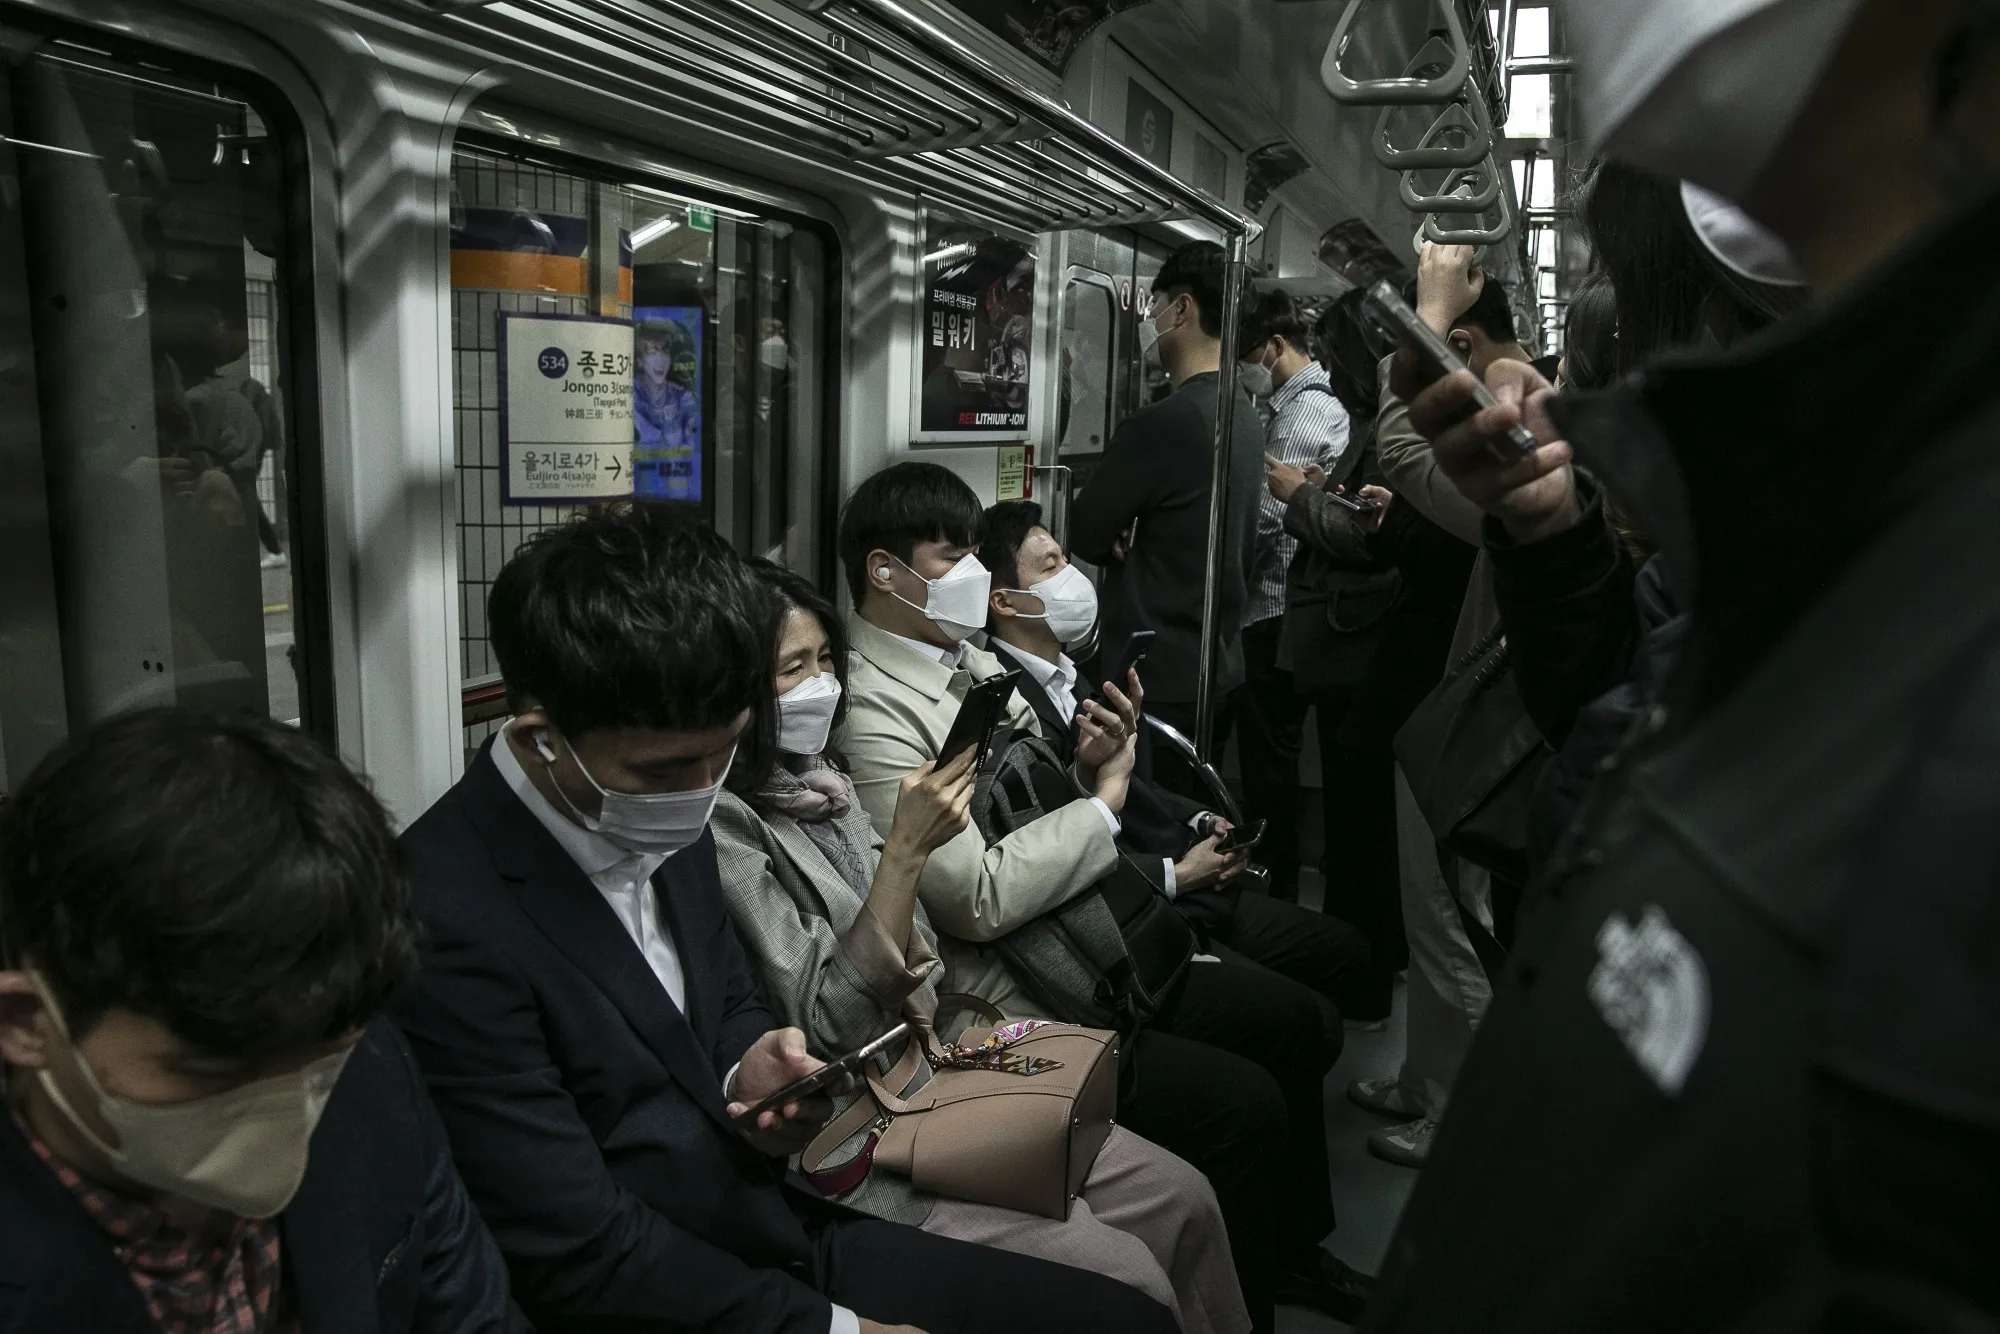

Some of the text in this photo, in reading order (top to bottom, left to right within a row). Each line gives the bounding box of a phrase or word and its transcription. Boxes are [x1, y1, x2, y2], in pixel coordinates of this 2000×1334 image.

[933, 289, 977, 311] 프리미엄 전동공구
[932, 311, 975, 351] 밀워키
[540, 355, 566, 370] 534
[562, 380, 608, 397] Jongno
[521, 451, 600, 472] 을지로4가
